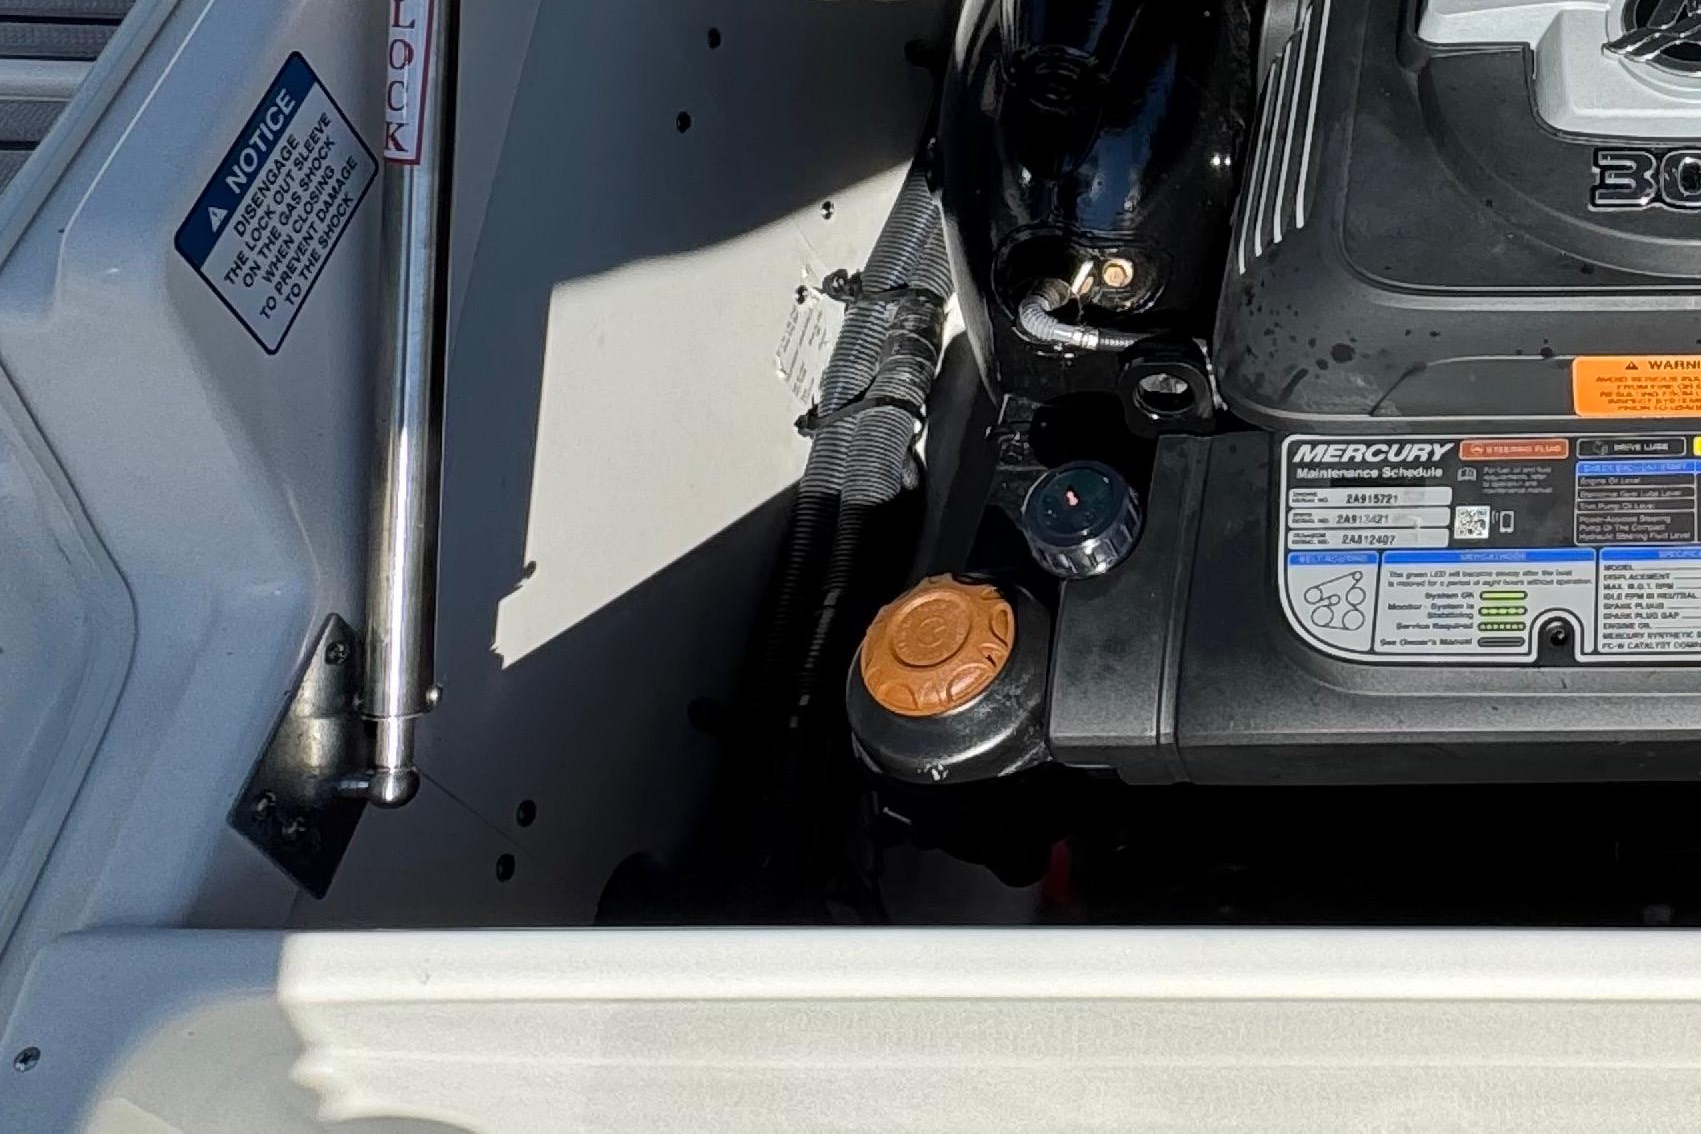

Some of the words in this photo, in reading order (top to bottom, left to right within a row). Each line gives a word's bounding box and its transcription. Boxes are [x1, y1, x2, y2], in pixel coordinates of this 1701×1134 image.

[225, 88, 296, 194] NOTICE
[233, 133, 301, 238] DISENGAGE
[224, 250, 249, 285] THE
[245, 204, 276, 252] LOCK
[273, 169, 296, 206] OUT
[294, 111, 332, 173] SLEEVE
[243, 260, 261, 288] ON
[257, 225, 282, 261] THE
[279, 191, 302, 226] GAS
[300, 135, 336, 193] SHOCK
[262, 234, 295, 284] WHEN
[292, 165, 335, 234] CLOSING
[259, 296, 277, 320] TO
[274, 222, 318, 296] PREVENT
[316, 155, 359, 223] DAMAGE
[284, 283, 301, 306] TO
[299, 248, 321, 281] THE
[318, 192, 355, 249] SHOCK
[1293, 443, 1455, 463] MERCURY
[1296, 468, 1379, 480] Maintenance
[1382, 466, 1443, 479] Schedule
[1405, 571, 1429, 579] green
[1425, 591, 1459, 600] System
[1431, 602, 1464, 611] System
[1396, 622, 1430, 630] Service
[1432, 622, 1473, 631] Required
[1380, 638, 1397, 646] See
[1439, 637, 1473, 645] Manual
[1603, 632, 1645, 640] MERCURY
[1627, 641, 1670, 649] CATALYST
